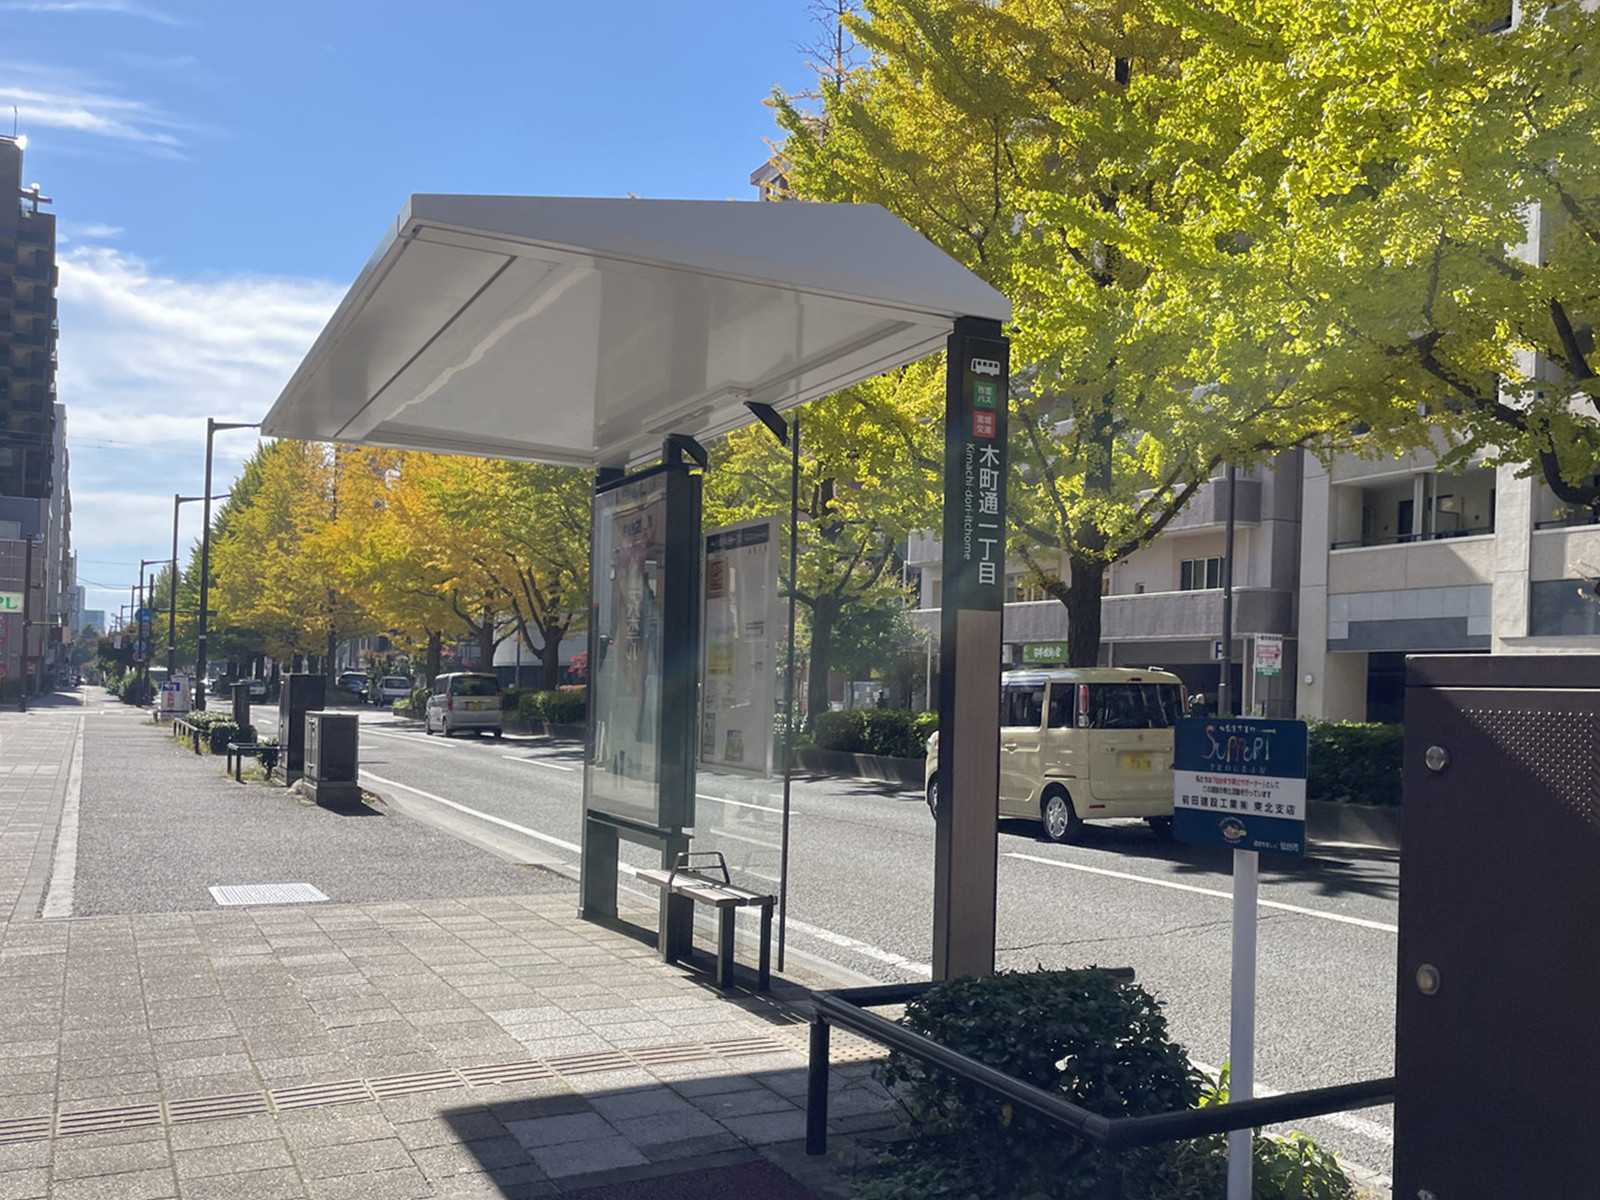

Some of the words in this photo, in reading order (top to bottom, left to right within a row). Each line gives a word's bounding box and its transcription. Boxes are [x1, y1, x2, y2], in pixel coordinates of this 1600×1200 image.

[976, 395, 993, 405] バス
[963, 443, 975, 560] Kimachi-dori-itchome
[978, 444, 1000, 585] 木町通一丁目
[1210, 763, 1266, 775] PROGRAM
[1253, 802, 1296, 816] 東北支店
